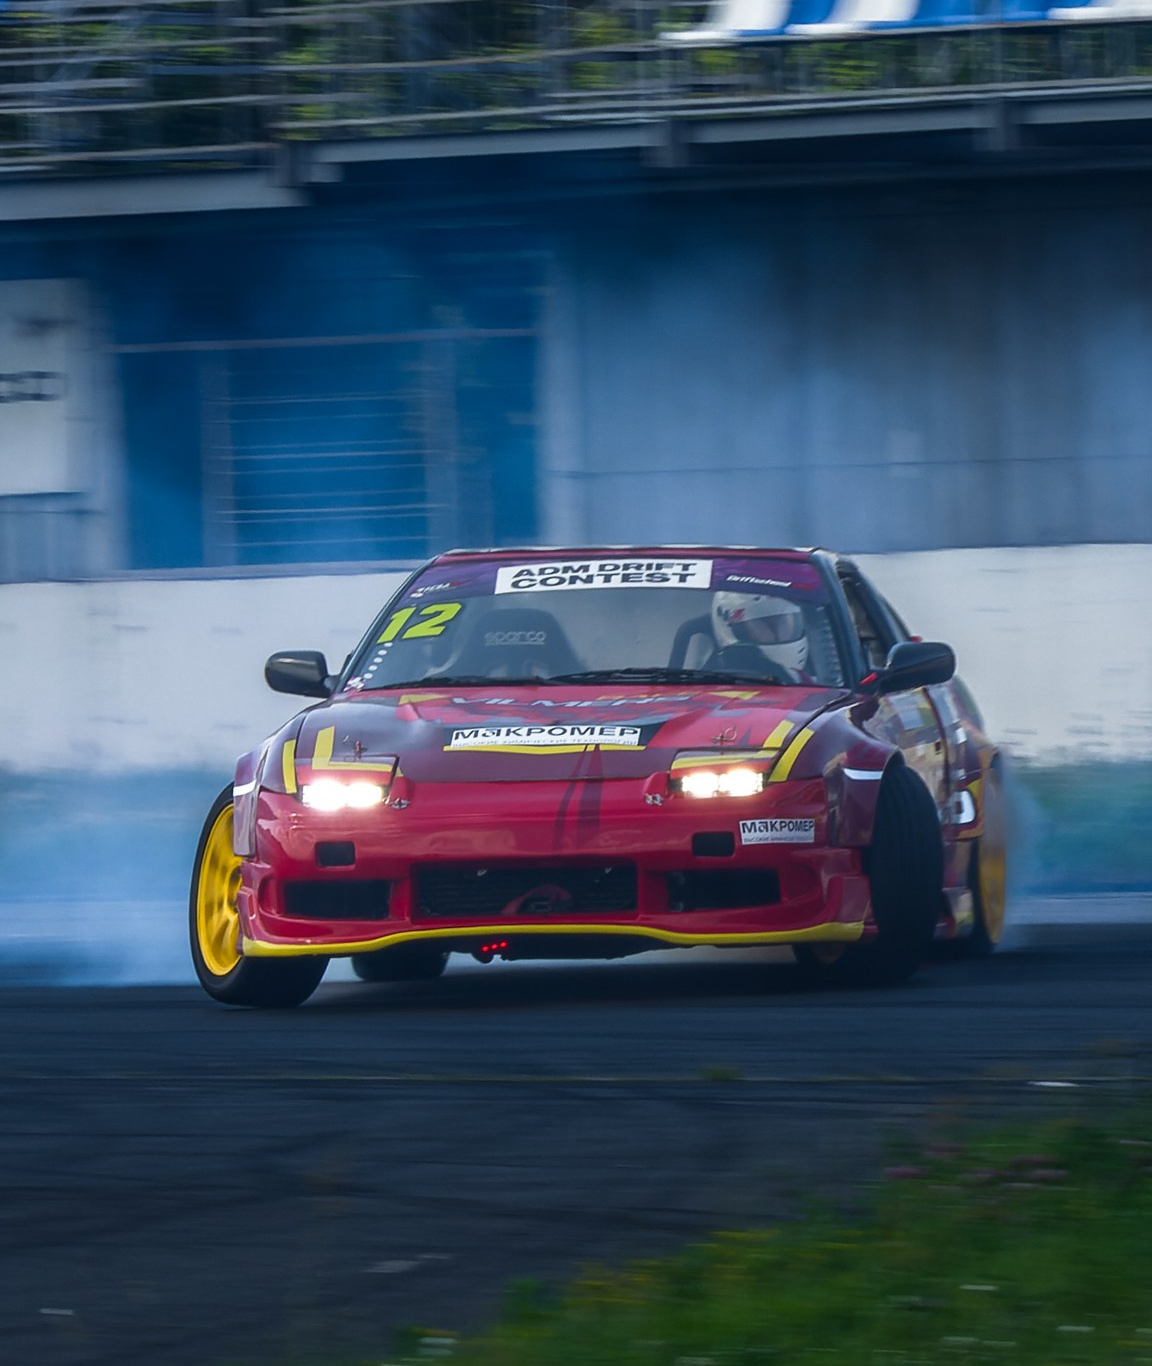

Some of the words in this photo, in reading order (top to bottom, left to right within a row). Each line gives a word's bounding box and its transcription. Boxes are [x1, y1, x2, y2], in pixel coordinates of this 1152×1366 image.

[512, 563, 590, 578] ADM
[598, 562, 697, 573] DRIFT
[510, 571, 697, 589] CONTEST
[376, 602, 463, 644] 12
[485, 631, 547, 644] sparco
